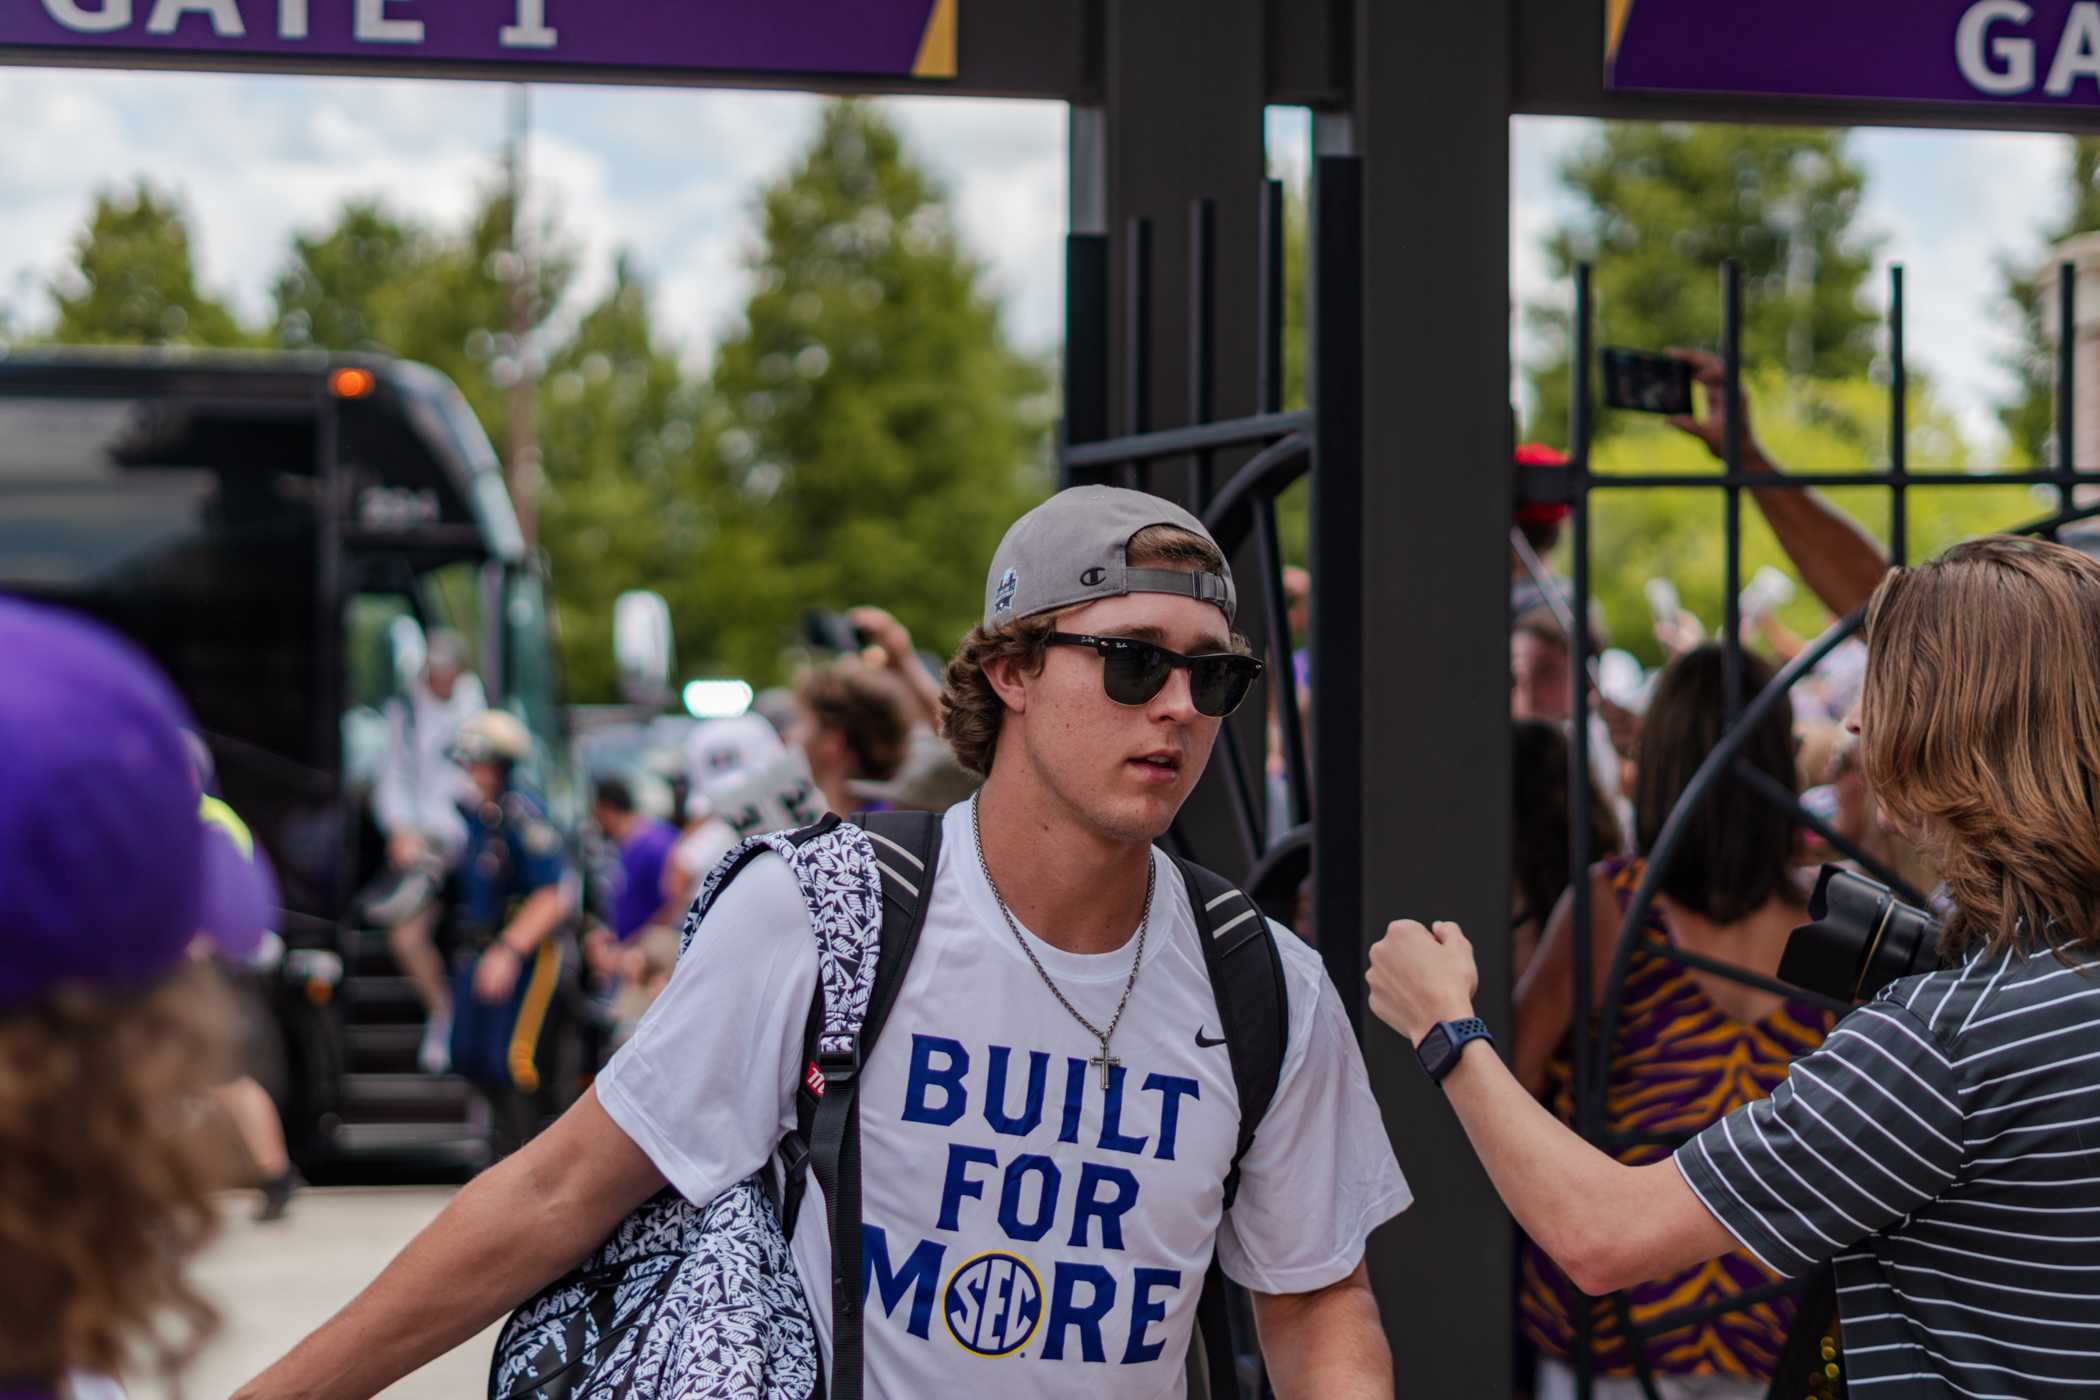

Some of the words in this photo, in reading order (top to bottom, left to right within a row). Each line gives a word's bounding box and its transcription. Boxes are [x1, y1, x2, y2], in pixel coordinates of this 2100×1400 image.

[901, 1033, 1200, 1161] BUILT
[936, 1143, 1140, 1251] FOR
[944, 1254, 1042, 1355] SEC
